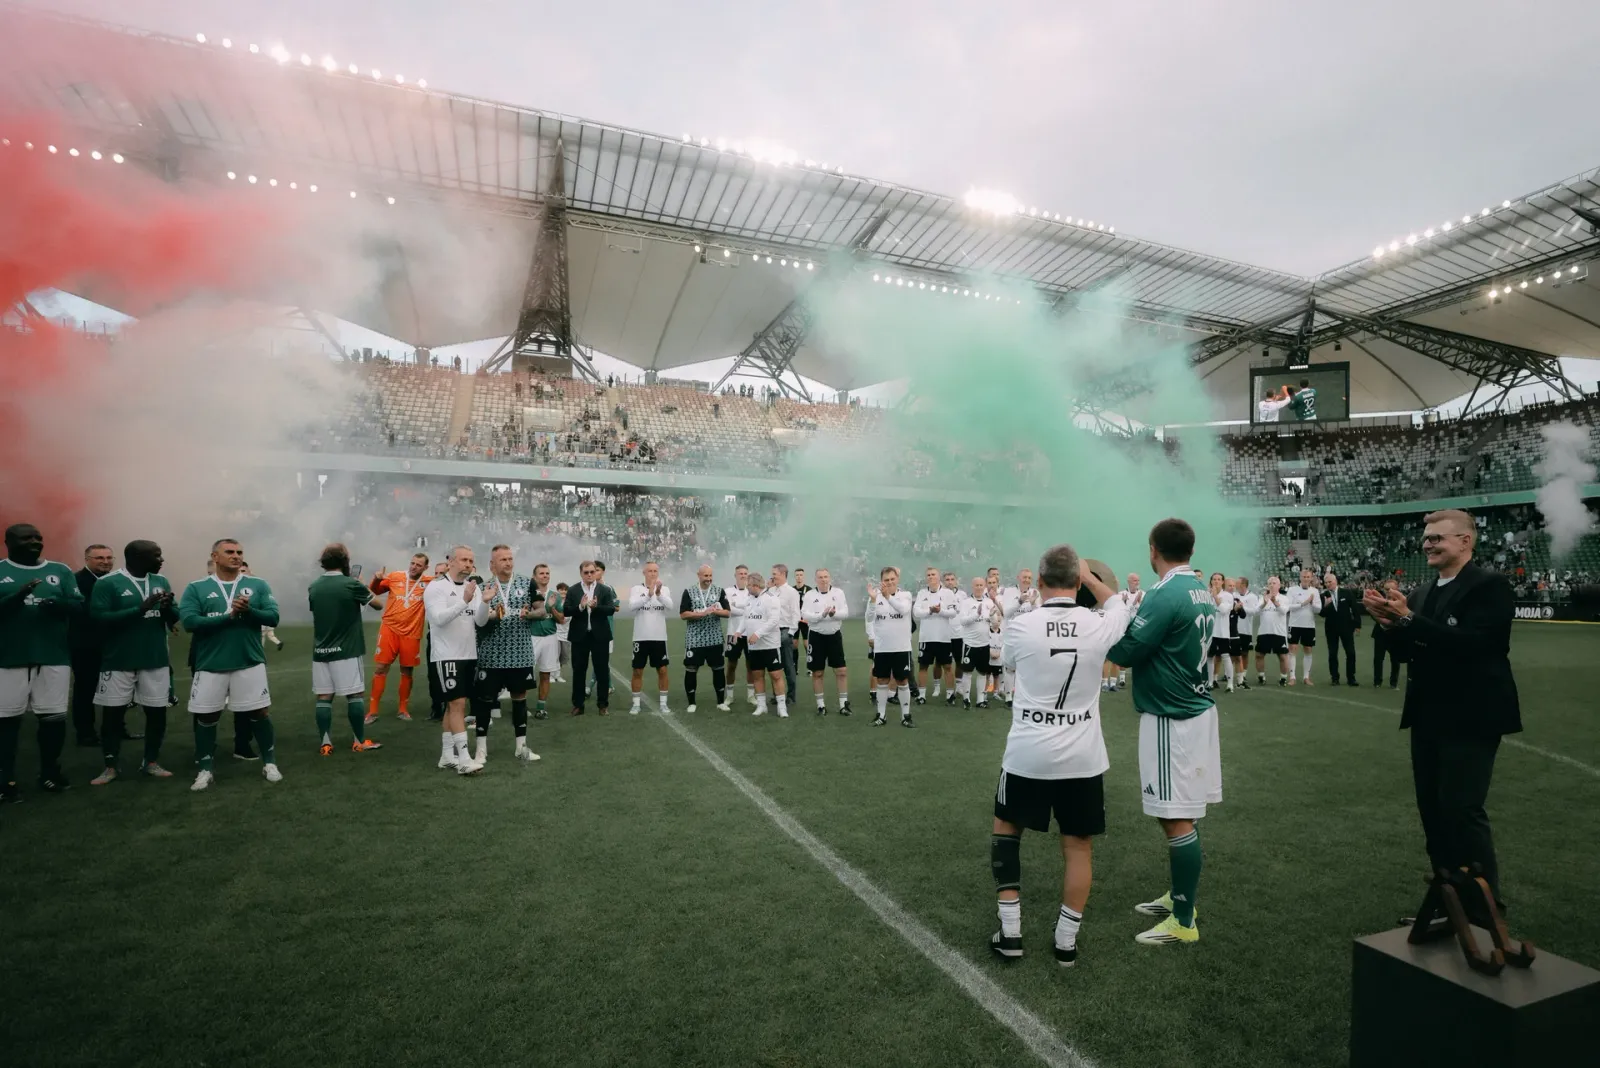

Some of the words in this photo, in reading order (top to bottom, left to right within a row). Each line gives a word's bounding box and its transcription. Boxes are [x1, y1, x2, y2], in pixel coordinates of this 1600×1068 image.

[1515, 607, 1541, 618] MOJA
[1046, 621, 1078, 638] PISZ
[444, 661, 458, 678] 14
[1050, 648, 1078, 710] 7
[1021, 708, 1092, 726] FORTUA
